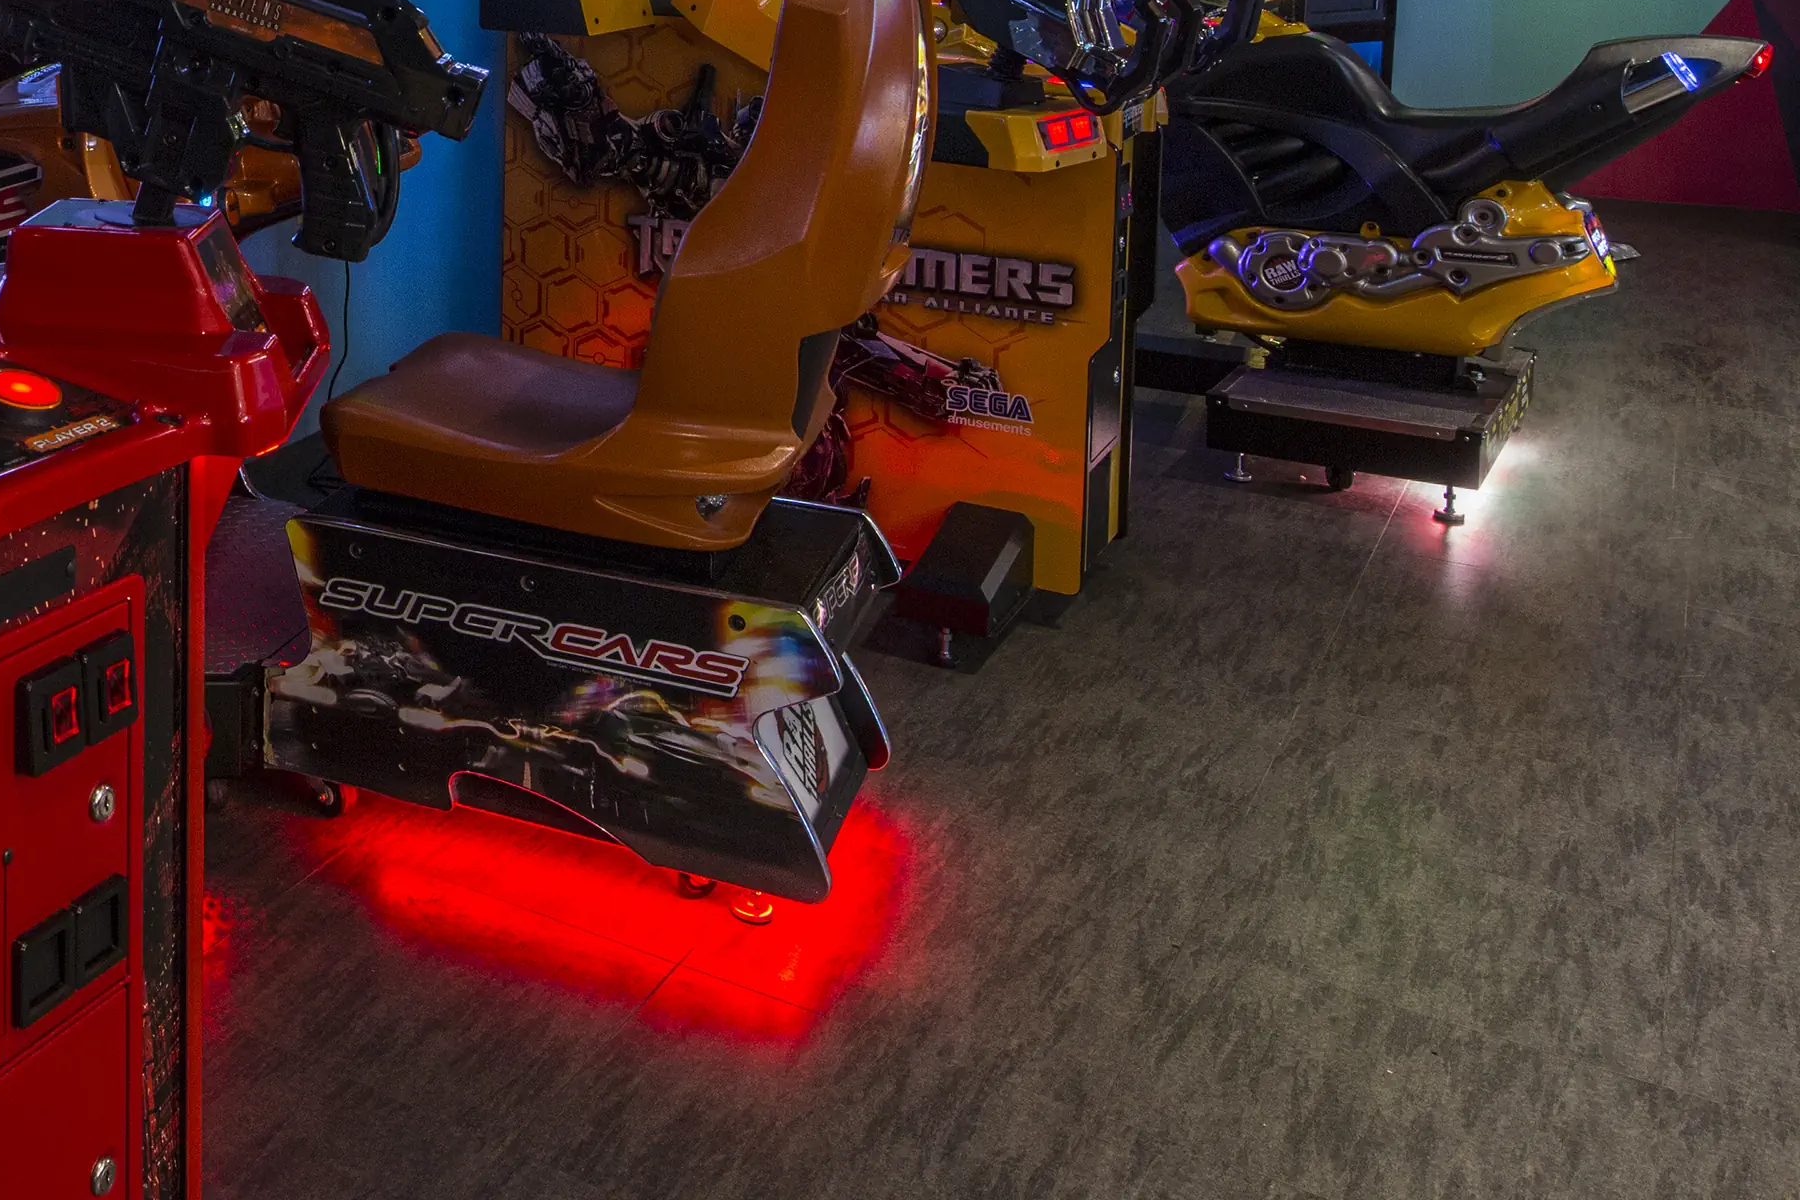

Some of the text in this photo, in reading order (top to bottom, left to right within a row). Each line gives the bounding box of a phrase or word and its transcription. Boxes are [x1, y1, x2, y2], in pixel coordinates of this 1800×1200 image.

[1264, 259, 1297, 280] RAW
[1269, 270, 1301, 286] THRILLS
[924, 296, 1056, 325] ALLIANCE
[946, 385, 1035, 424] SEGA
[33, 417, 112, 451] PLAYER 2
[947, 415, 1032, 436] amusements
[320, 577, 750, 697] SUPERCARS
